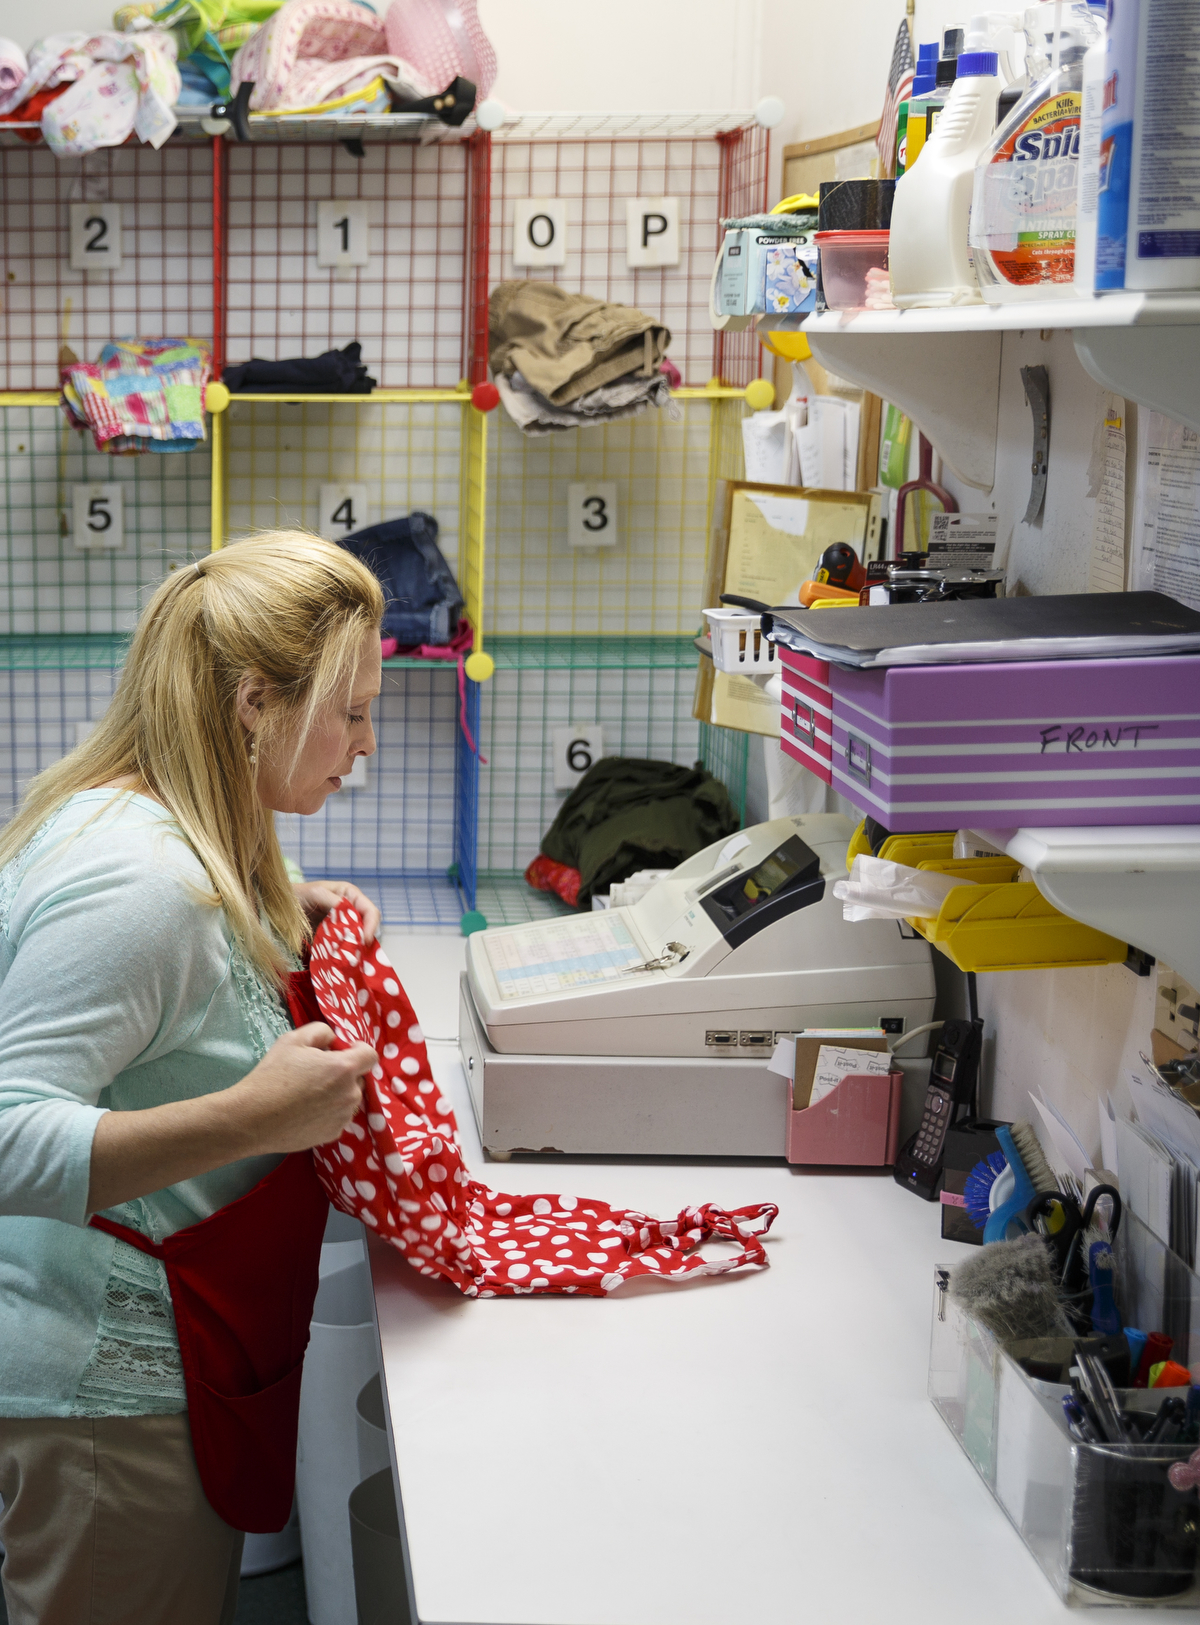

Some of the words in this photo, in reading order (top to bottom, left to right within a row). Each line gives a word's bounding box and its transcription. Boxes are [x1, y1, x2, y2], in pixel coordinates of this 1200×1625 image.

[1055, 98, 1074, 109] Kills
[83, 221, 109, 253] 2
[333, 216, 350, 251] 1
[642, 213, 668, 247] P
[1038, 230, 1064, 239] SPRAY
[88, 498, 112, 533] 5
[331, 498, 356, 531] 4
[582, 496, 608, 532] 3
[566, 739, 592, 772] 6
[1040, 725, 1159, 754] FRONT
